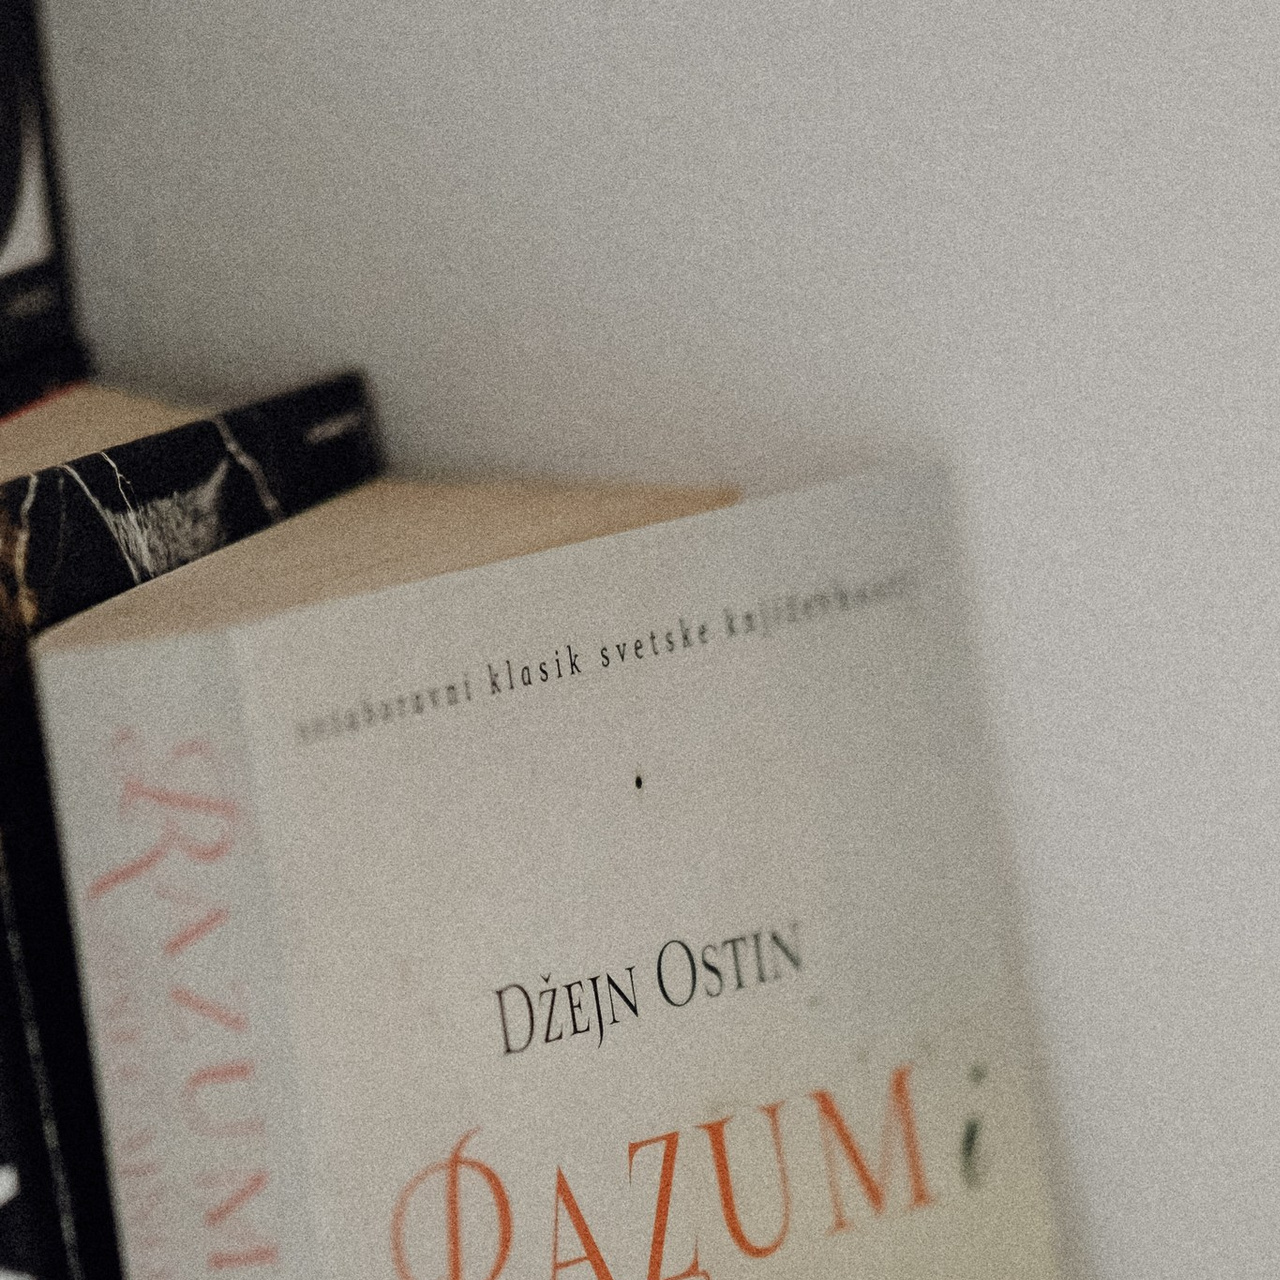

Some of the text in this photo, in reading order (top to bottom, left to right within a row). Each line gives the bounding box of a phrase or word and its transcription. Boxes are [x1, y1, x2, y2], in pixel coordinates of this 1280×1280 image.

[488, 645, 582, 694] klasik
[600, 616, 709, 668] svetske
[495, 924, 801, 1055] DŽEJN OSTIN
